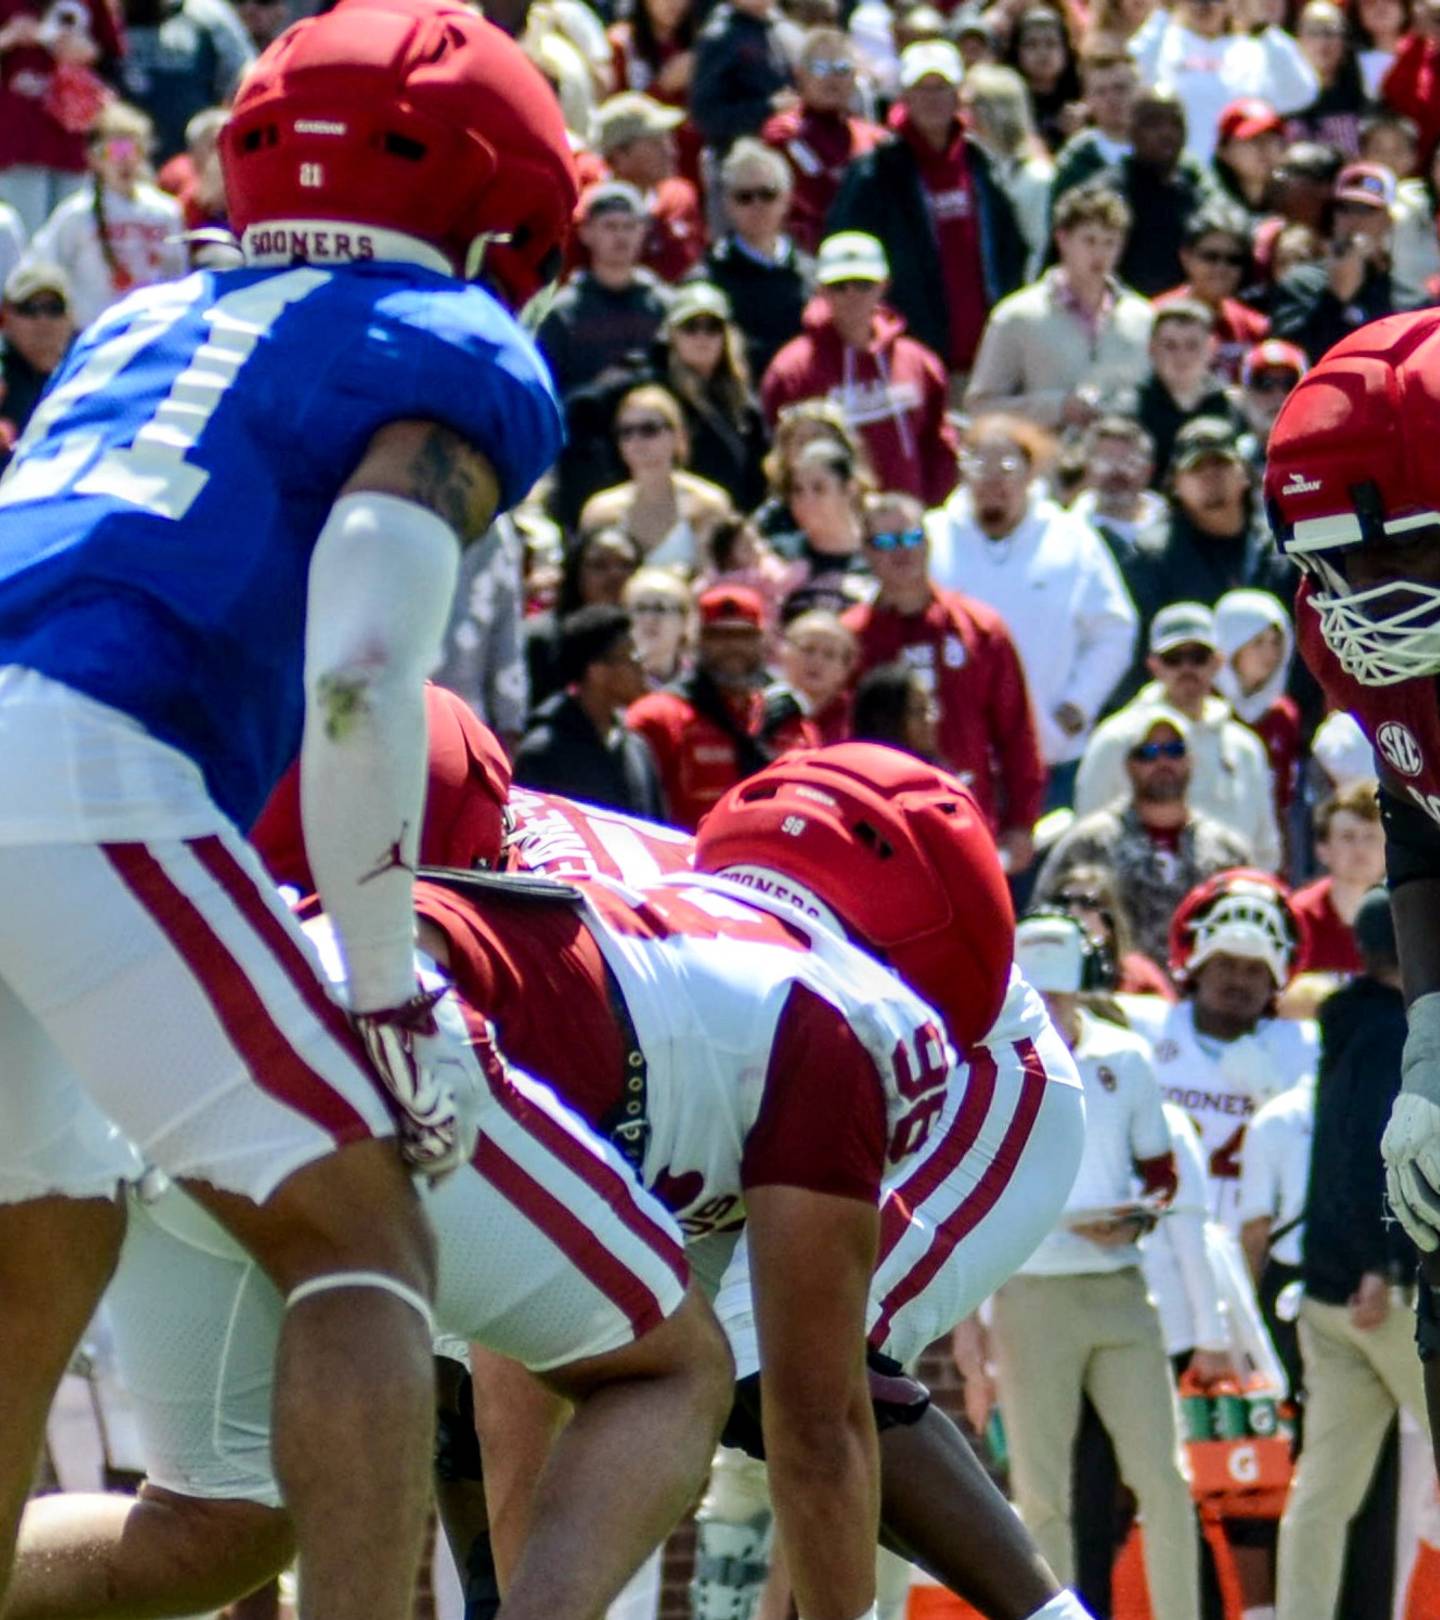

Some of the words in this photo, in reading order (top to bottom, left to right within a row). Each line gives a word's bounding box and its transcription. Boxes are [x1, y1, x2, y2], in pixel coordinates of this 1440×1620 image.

[251, 230, 375, 259] SOONERS
[1379, 725, 1419, 773] SEC
[1229, 1446, 1259, 1483] G
